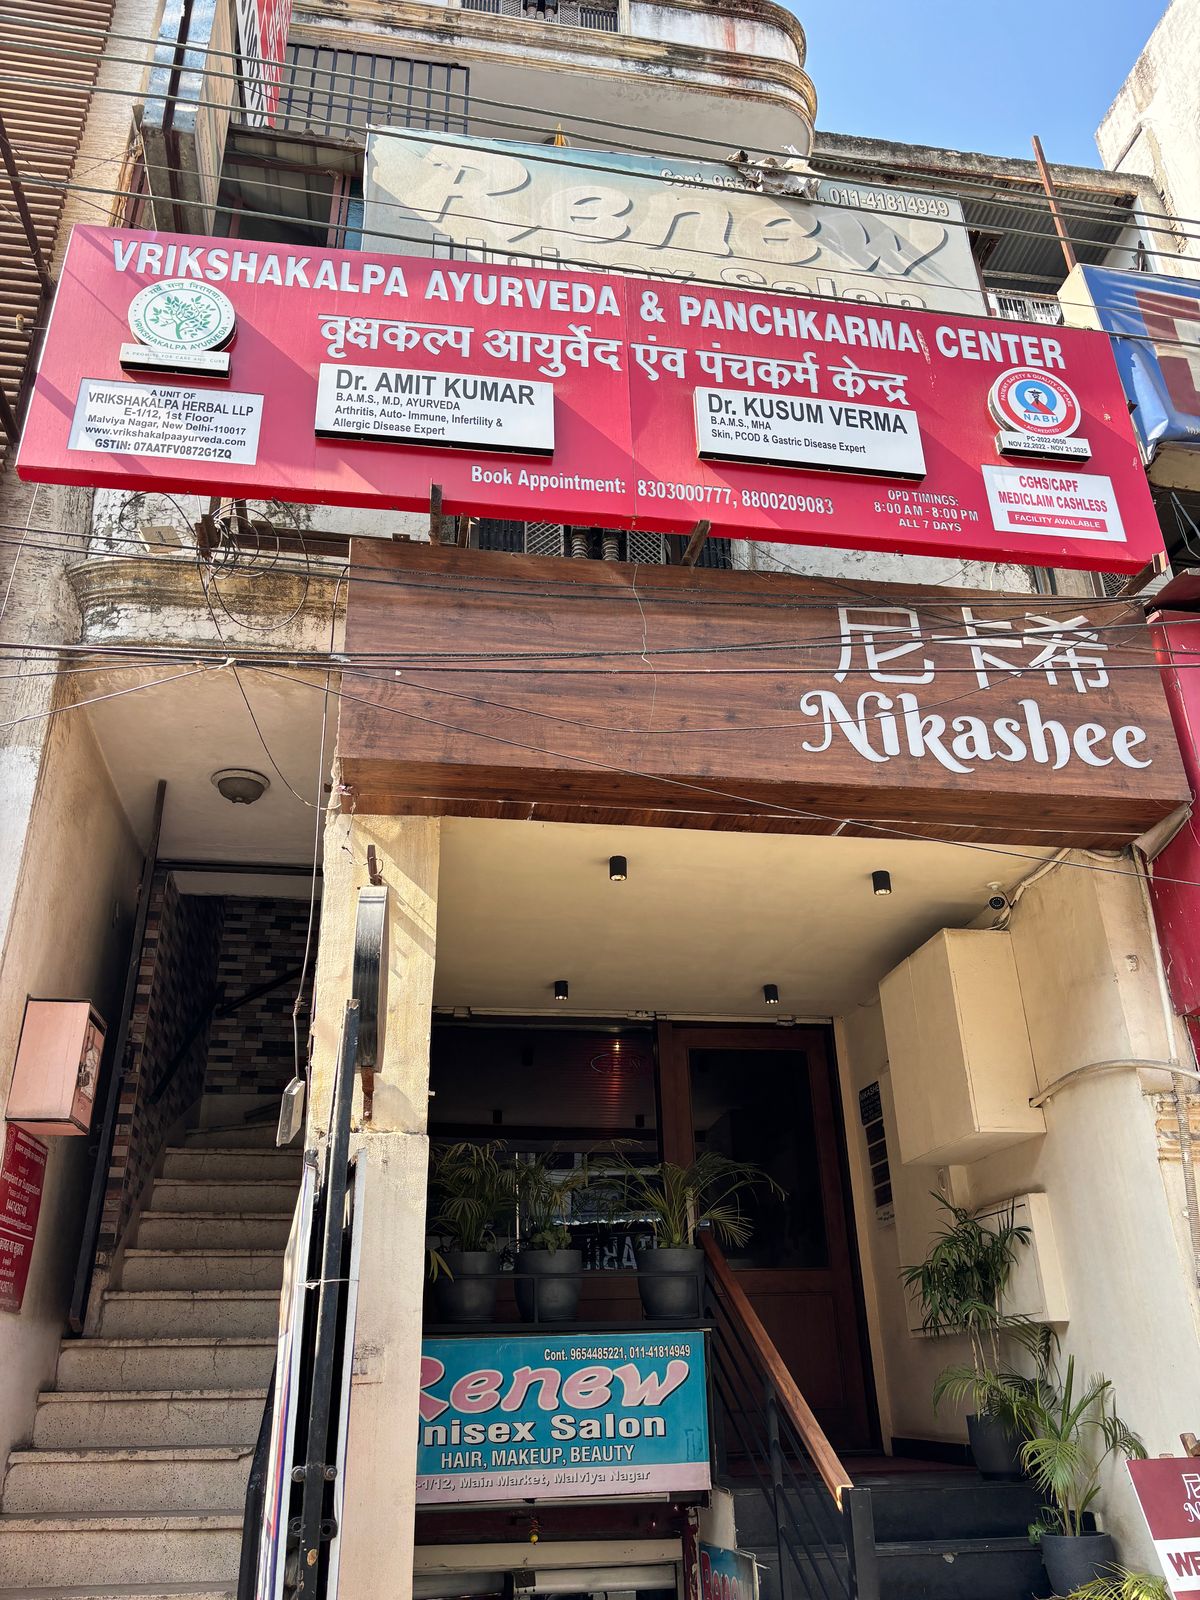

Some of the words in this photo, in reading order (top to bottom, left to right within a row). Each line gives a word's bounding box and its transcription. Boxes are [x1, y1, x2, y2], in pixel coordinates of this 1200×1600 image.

[112, 239, 409, 298] VRIKSHAKALPA
[425, 269, 621, 317] AYURVEDA
[639, 290, 666, 323] &
[679, 295, 920, 353] PANCHKARMA
[935, 326, 1067, 369] CENTER
[134, 318, 187, 351] VRIKSHAKALPA
[190, 326, 229, 350] AYURVEDA
[318, 313, 474, 358] वृक्षकल्प
[482, 324, 623, 378] आयुर्वेद
[696, 343, 820, 393] पंचकर्म
[827, 356, 910, 405] केन्द्र
[336, 369, 367, 390] Dr.
[375, 372, 436, 396] AMIT
[444, 377, 535, 406] KUMAR
[1032, 374, 1057, 387] QUALITY
[88, 392, 179, 410] VRIKSHAKALPA
[181, 402, 229, 415] HERBAL
[232, 405, 254, 417] LLP
[150, 389, 157, 397] A
[160, 390, 181, 399] UNIT
[336, 392, 379, 406] B.A.M.S.,
[406, 398, 460, 411] AYURVEDA
[124, 407, 161, 420] E-1/12,
[165, 410, 182, 421] 1st
[185, 412, 215, 424] Floor
[335, 404, 377, 418] Arthritis,
[380, 408, 406, 419] Auto-
[408, 410, 449, 424] Immune,
[451, 414, 494, 428] Infertility
[496, 418, 503, 428] &
[708, 393, 737, 415] Dr.
[744, 397, 824, 424] KUSUM
[829, 405, 908, 434] VERMA
[710, 416, 749, 429] B.A.M.S.,
[751, 420, 771, 431] MHA
[1024, 413, 1059, 423] NABH
[88, 415, 125, 426] Malviya
[128, 417, 159, 430] Nagar,
[162, 421, 183, 431] New
[186, 423, 247, 436] Delhi-110017
[333, 417, 370, 431] Allergic
[373, 421, 411, 433] Disease
[414, 424, 446, 437] Expert
[85, 426, 247, 447] www.vrikshakalpaayurveda.com
[95, 438, 131, 451] GSTIN:
[711, 429, 733, 440] Skin,
[735, 431, 760, 442] PCOD
[763, 434, 769, 443] &
[772, 436, 802, 447] Gastric
[804, 438, 836, 450] Disease
[839, 442, 866, 454] Expert
[471, 465, 512, 485] Book
[516, 469, 626, 494] Appointment:
[637, 480, 738, 508] 8303000777,
[741, 490, 834, 515] 8800209083
[1019, 475, 1079, 493] CGHS/CAPF
[888, 489, 910, 502] OPD
[912, 491, 959, 506] TIMINGS:
[997, 490, 1054, 510] MEDICLAIM
[1056, 496, 1108, 513] CASHLESS
[874, 501, 899, 515] 8:00
[932, 505, 958, 520] 8:00
[899, 518, 921, 530] ALL
[924, 519, 930, 530] 7
[933, 519, 962, 532] DAYS
[1014, 514, 1052, 526] FACILITY
[1054, 517, 1101, 529] AVAILABLE
[834, 605, 1109, 693] 尼卡希
[799, 690, 1153, 774] Nikashee
[544, 1348, 568, 1361] Cont.
[570, 1346, 627, 1361] 9654485221,
[629, 1344, 690, 1359] 011-41814949
[419, 1419, 536, 1447] nisex
[551, 1413, 667, 1441] Salon
[441, 1451, 487, 1470] HAIR,
[492, 1448, 566, 1467] MAKEUP,
[570, 1444, 635, 1463] BEAUTY
[416, 1478, 456, 1491] -1/12,
[459, 1476, 494, 1488] Main
[497, 1473, 550, 1488] Market,
[554, 1471, 606, 1485] Malviya
[609, 1470, 651, 1484] Nagar
